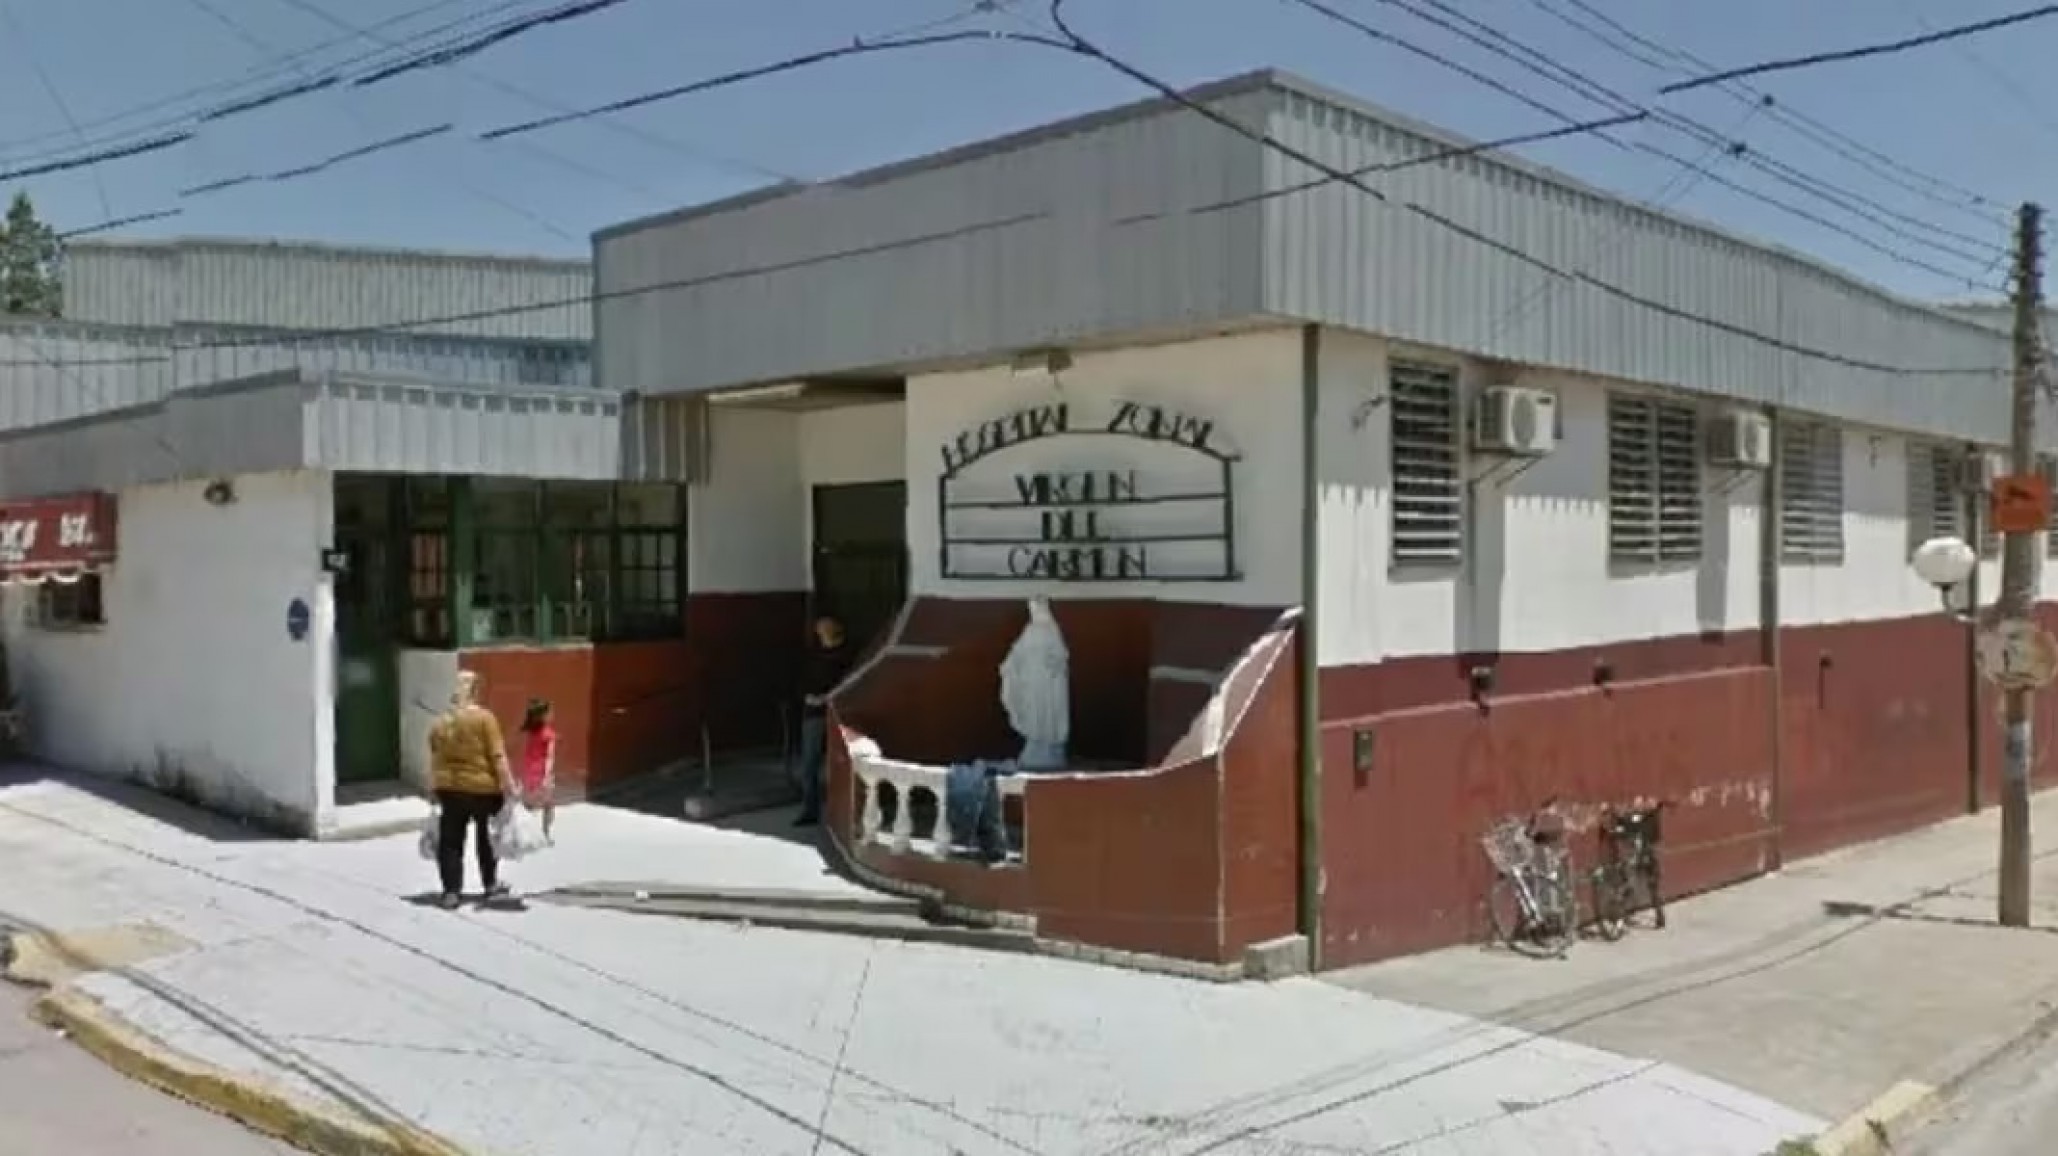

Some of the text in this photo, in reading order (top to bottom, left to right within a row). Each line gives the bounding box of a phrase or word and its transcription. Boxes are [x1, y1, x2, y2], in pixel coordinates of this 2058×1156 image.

[1015, 470, 1138, 504] VIRGEN
[1042, 511, 1110, 541] DEL
[1008, 547, 1146, 579] CARMEN
